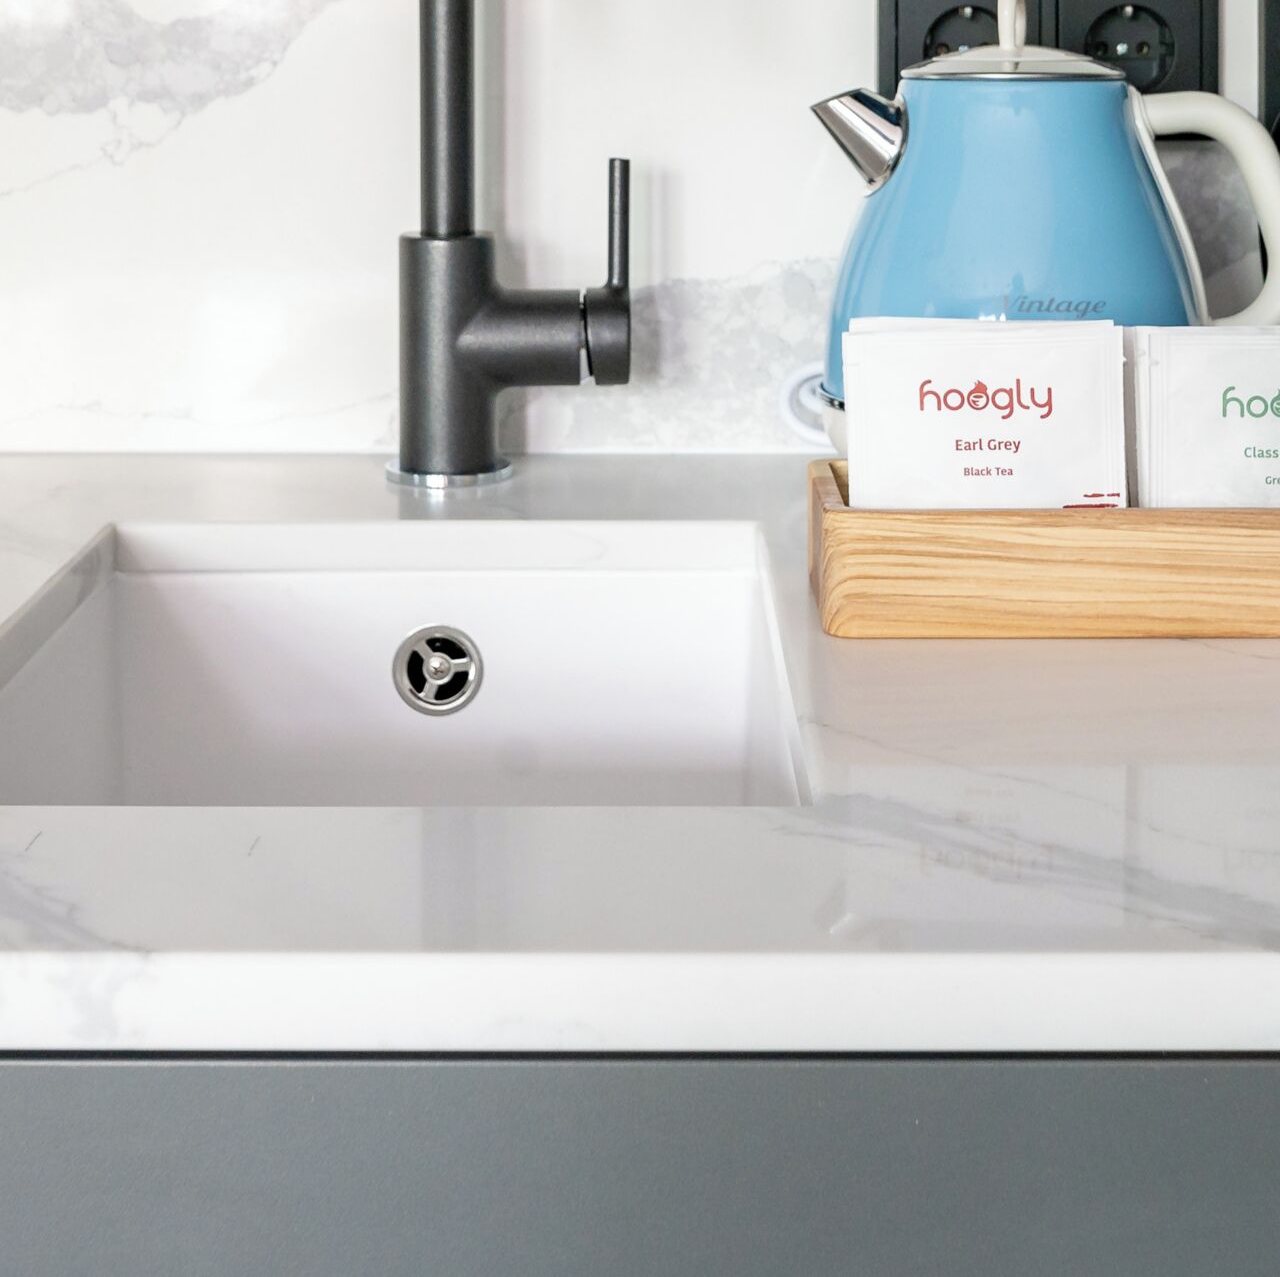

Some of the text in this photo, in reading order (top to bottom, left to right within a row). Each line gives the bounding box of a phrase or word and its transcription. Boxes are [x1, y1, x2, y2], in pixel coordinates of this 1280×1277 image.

[955, 438, 1021, 453] Earl Grey
[963, 466, 1014, 477] Black Tea
